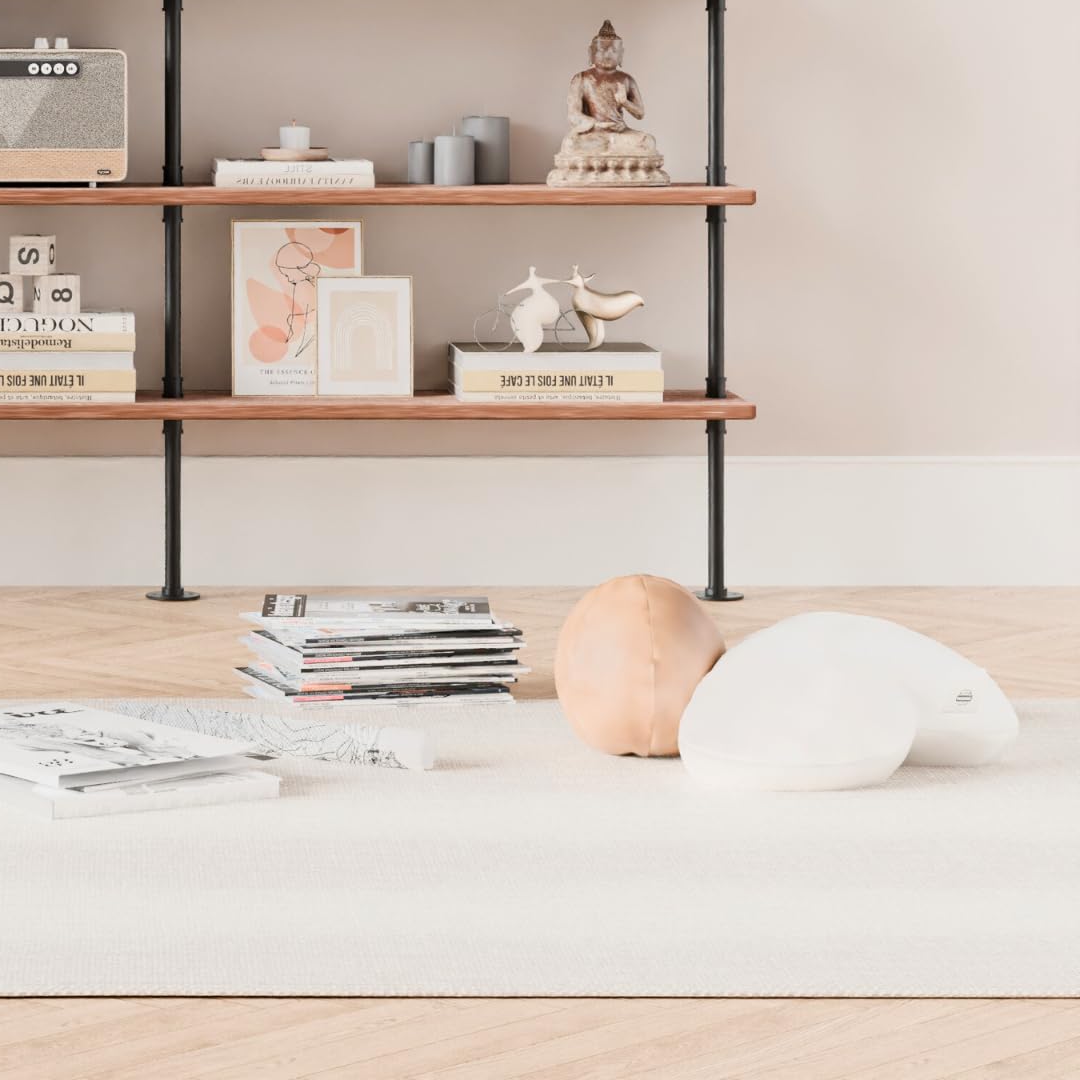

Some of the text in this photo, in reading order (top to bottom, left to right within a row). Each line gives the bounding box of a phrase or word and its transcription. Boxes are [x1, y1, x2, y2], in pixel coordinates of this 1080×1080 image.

[18, 247, 39, 264] S
[52, 288, 73, 302] 8
[0, 338, 72, 349] Remodelista
[7, 375, 26, 386] FOIS
[30, 375, 47, 386] UNE
[50, 375, 74, 389] ÉTAIT
[77, 375, 84, 386] IL
[500, 376, 613, 389] IL ÉTAIT UNE FOIS LE CAFÉ
